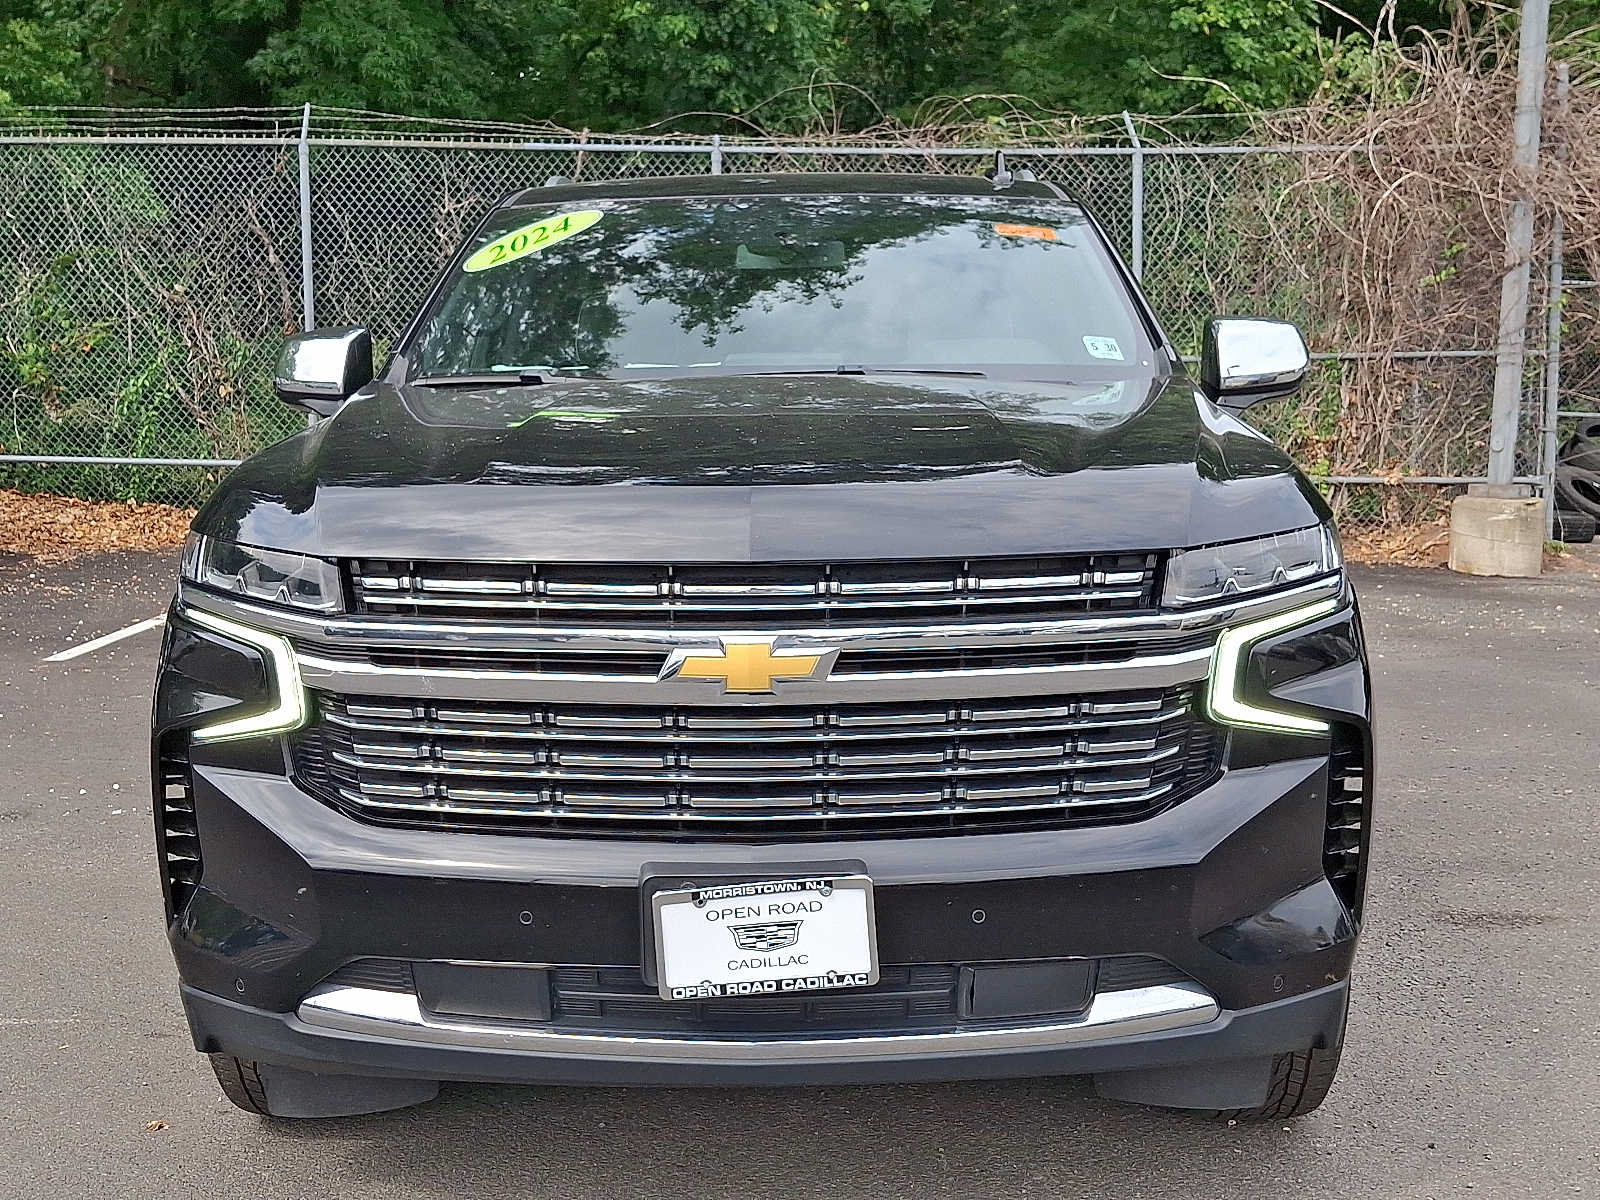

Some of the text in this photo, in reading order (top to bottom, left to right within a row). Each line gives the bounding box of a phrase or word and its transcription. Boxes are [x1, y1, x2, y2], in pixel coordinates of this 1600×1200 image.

[489, 216, 571, 264] 2024
[699, 880, 825, 900] MORRISTOWN, NJ
[705, 900, 823, 922] OPEN ROAD
[727, 954, 809, 971] CADILLAC
[672, 973, 868, 999] OPEN ROAD CADILLAC
